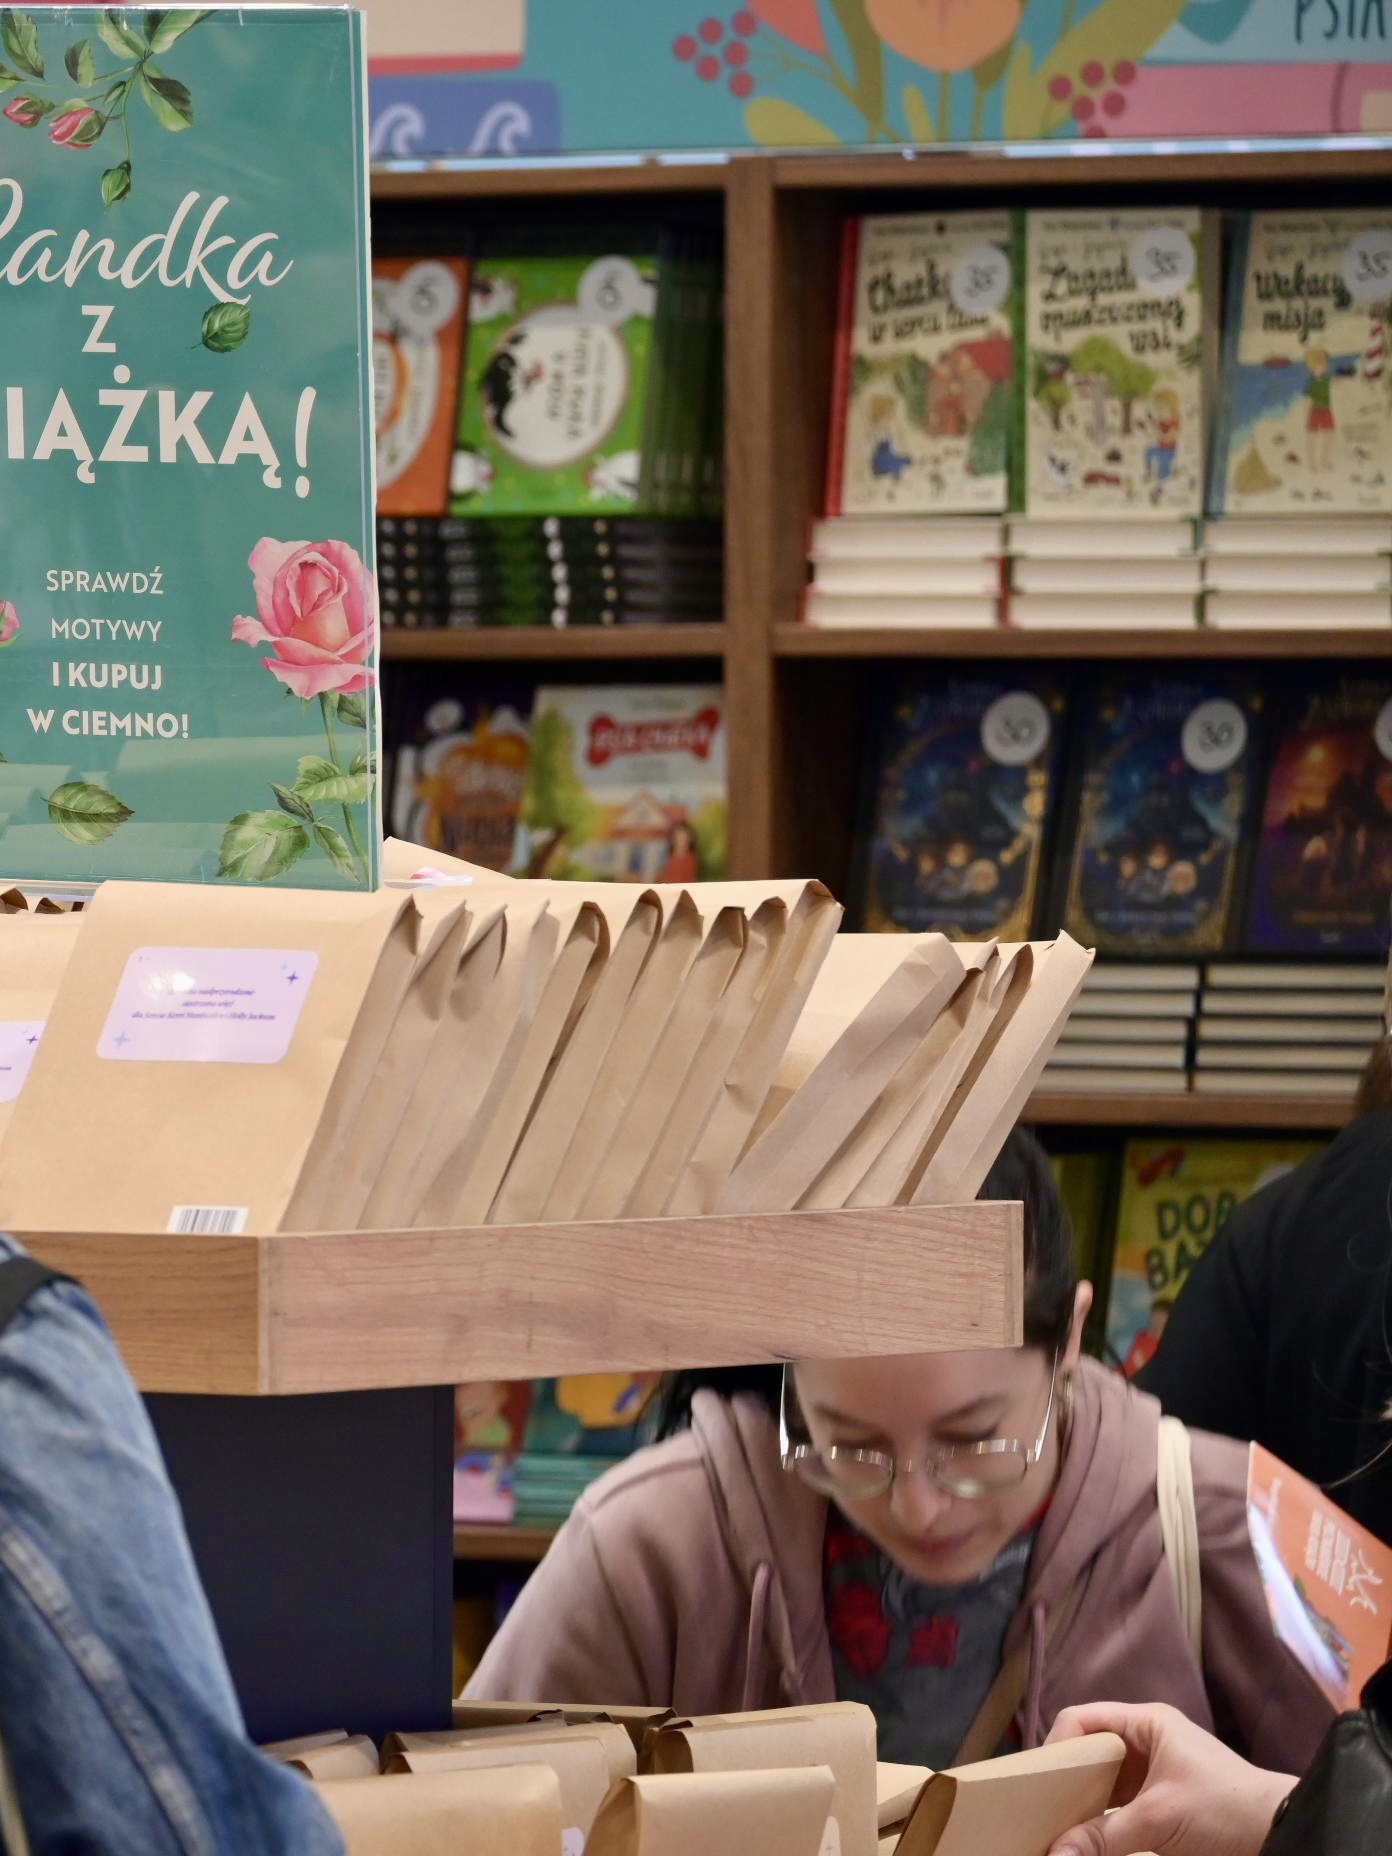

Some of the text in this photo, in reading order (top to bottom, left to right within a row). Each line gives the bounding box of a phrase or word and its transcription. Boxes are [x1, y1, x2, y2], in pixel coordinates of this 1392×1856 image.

[46, 565, 164, 595] SPRAWDŹ
[51, 617, 162, 642] MOTYWY
[52, 661, 162, 690] I KUPUJ
[26, 708, 189, 739] W CIEMNO!
